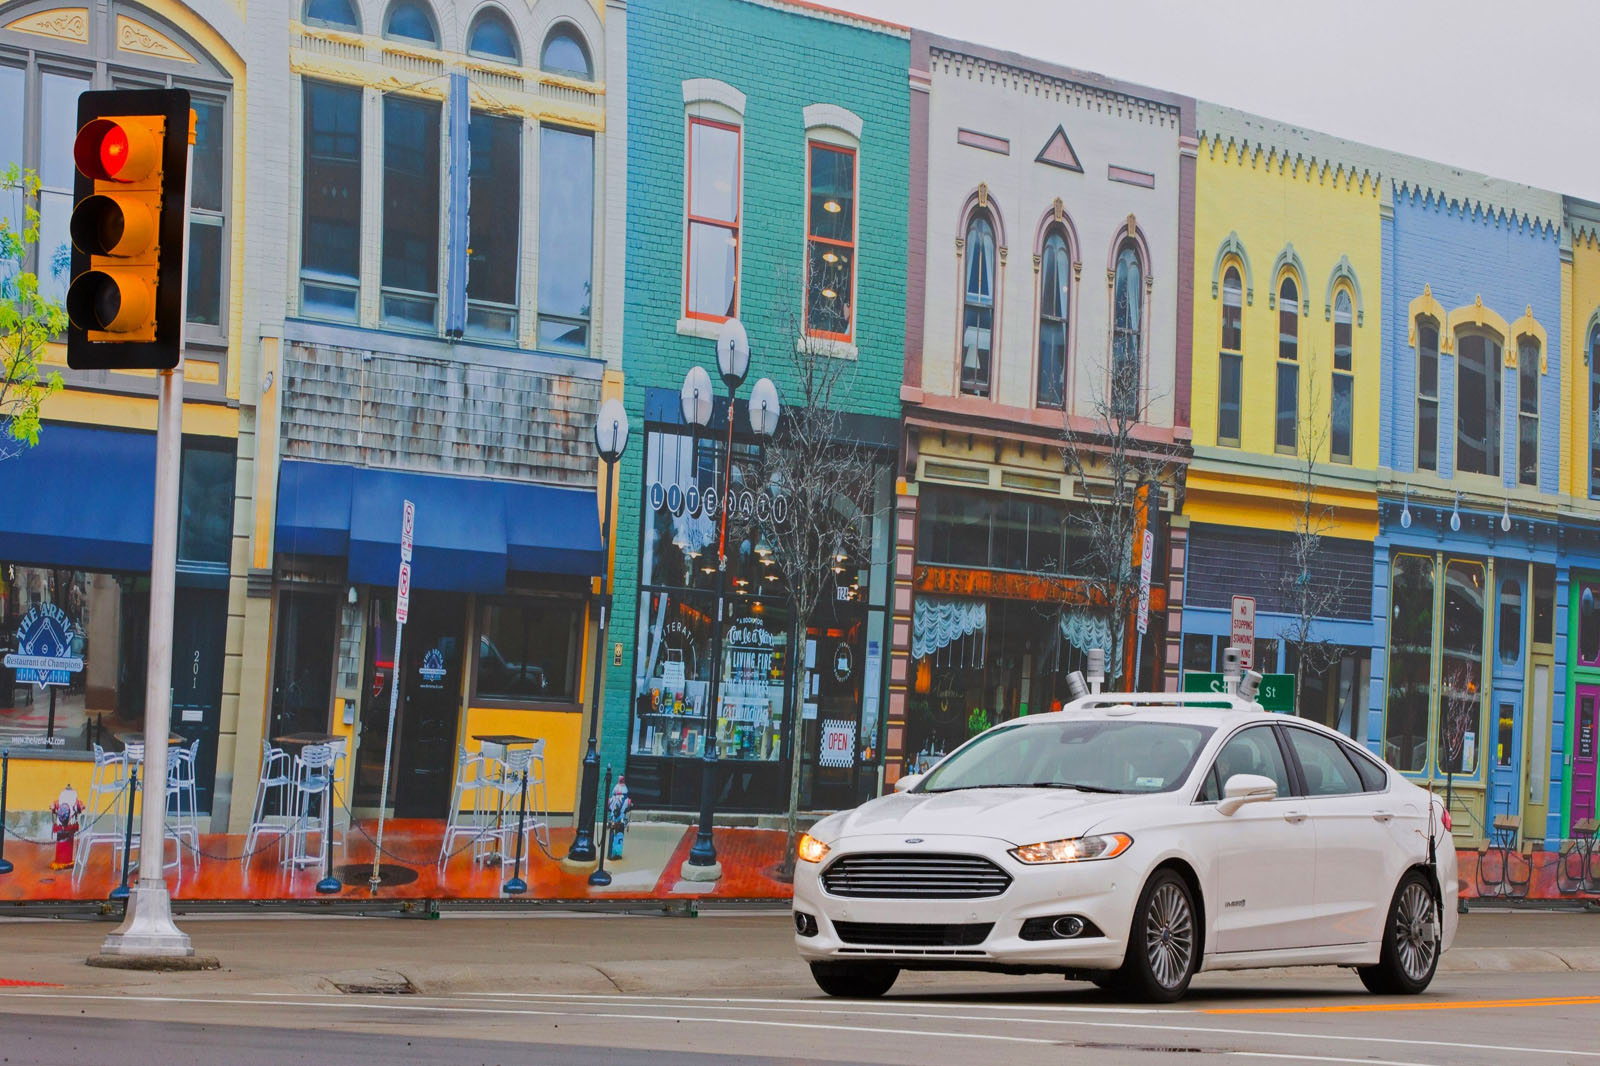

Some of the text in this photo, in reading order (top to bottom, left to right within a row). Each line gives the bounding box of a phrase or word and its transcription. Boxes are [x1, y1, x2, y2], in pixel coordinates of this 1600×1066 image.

[1240, 605, 1247, 615] NO
[16, 602, 74, 645] THE ARENA
[1233, 619, 1252, 630] STOPPING
[1233, 633, 1252, 644] STANDING
[6, 655, 82, 670] Restaurant of Champions
[733, 651, 756, 669] LIVING
[757, 653, 772, 670] FIRE
[192, 650, 200, 689] 201
[1265, 686, 1276, 698] St
[828, 732, 848, 750] OPEN
